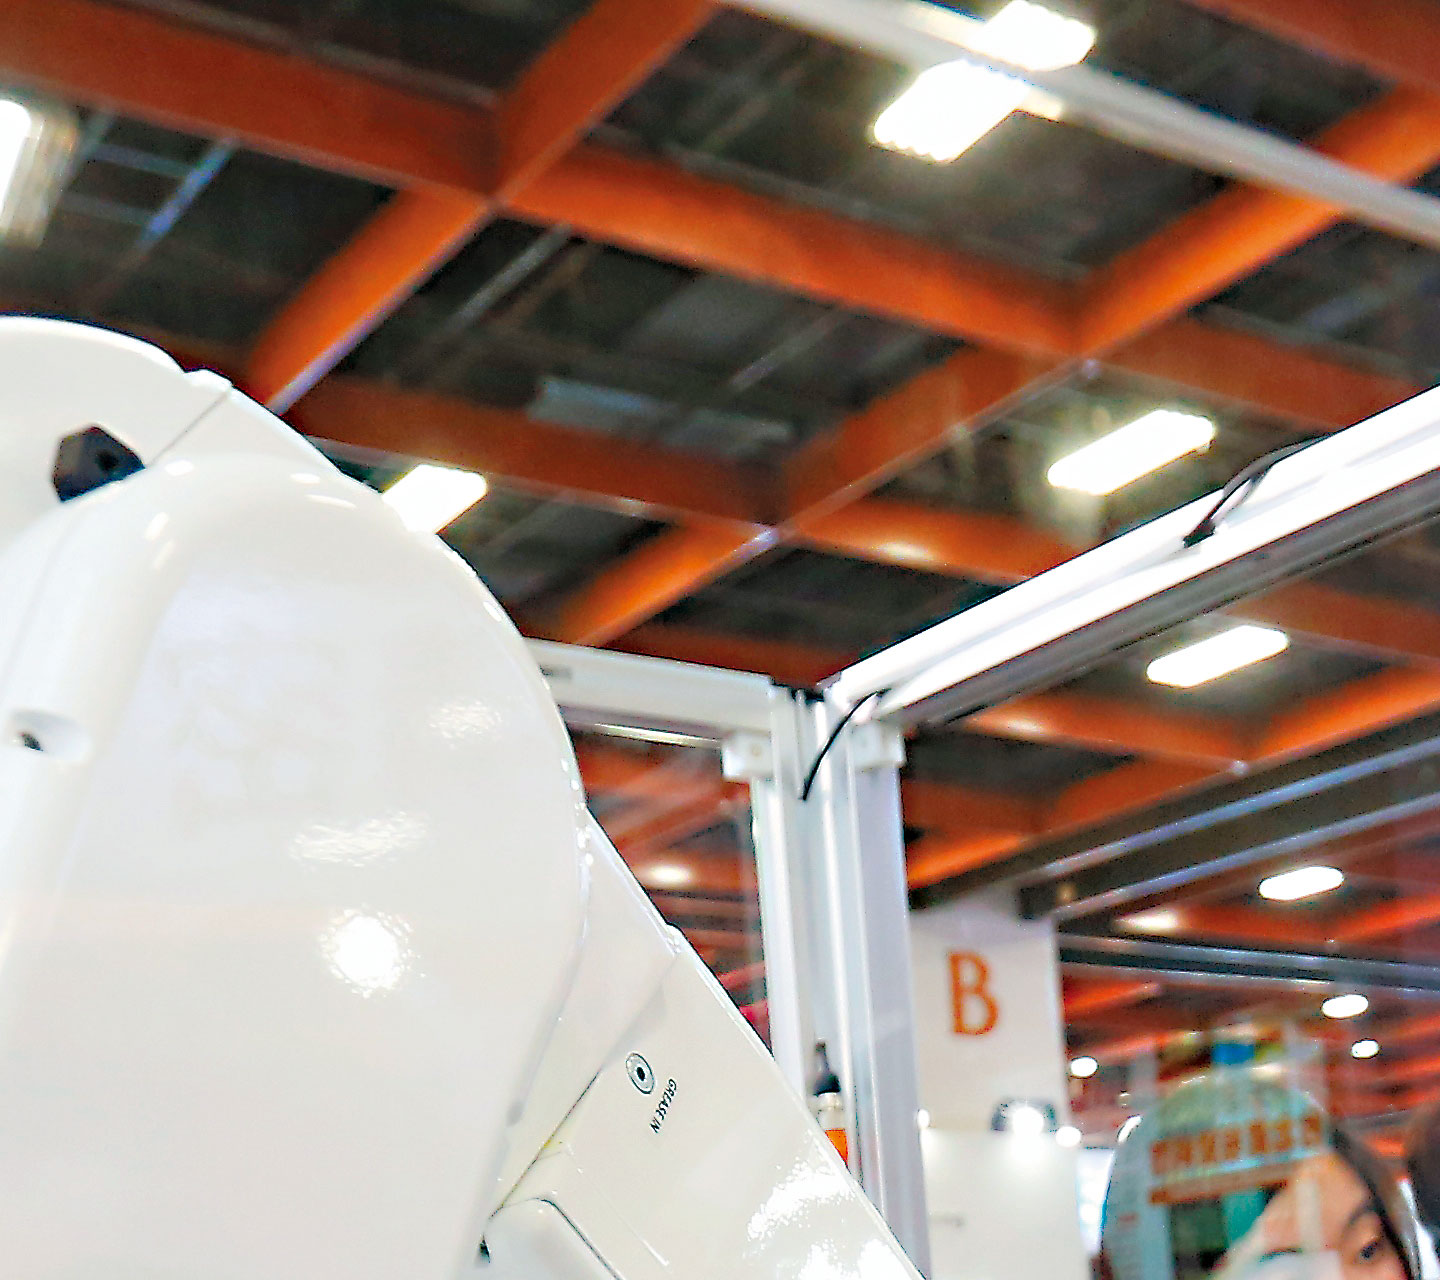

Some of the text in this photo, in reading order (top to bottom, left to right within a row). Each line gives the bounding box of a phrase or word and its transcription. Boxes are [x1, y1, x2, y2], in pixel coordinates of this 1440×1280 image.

[947, 950, 1000, 1037] B
[649, 1078, 677, 1134] GREASE IN
